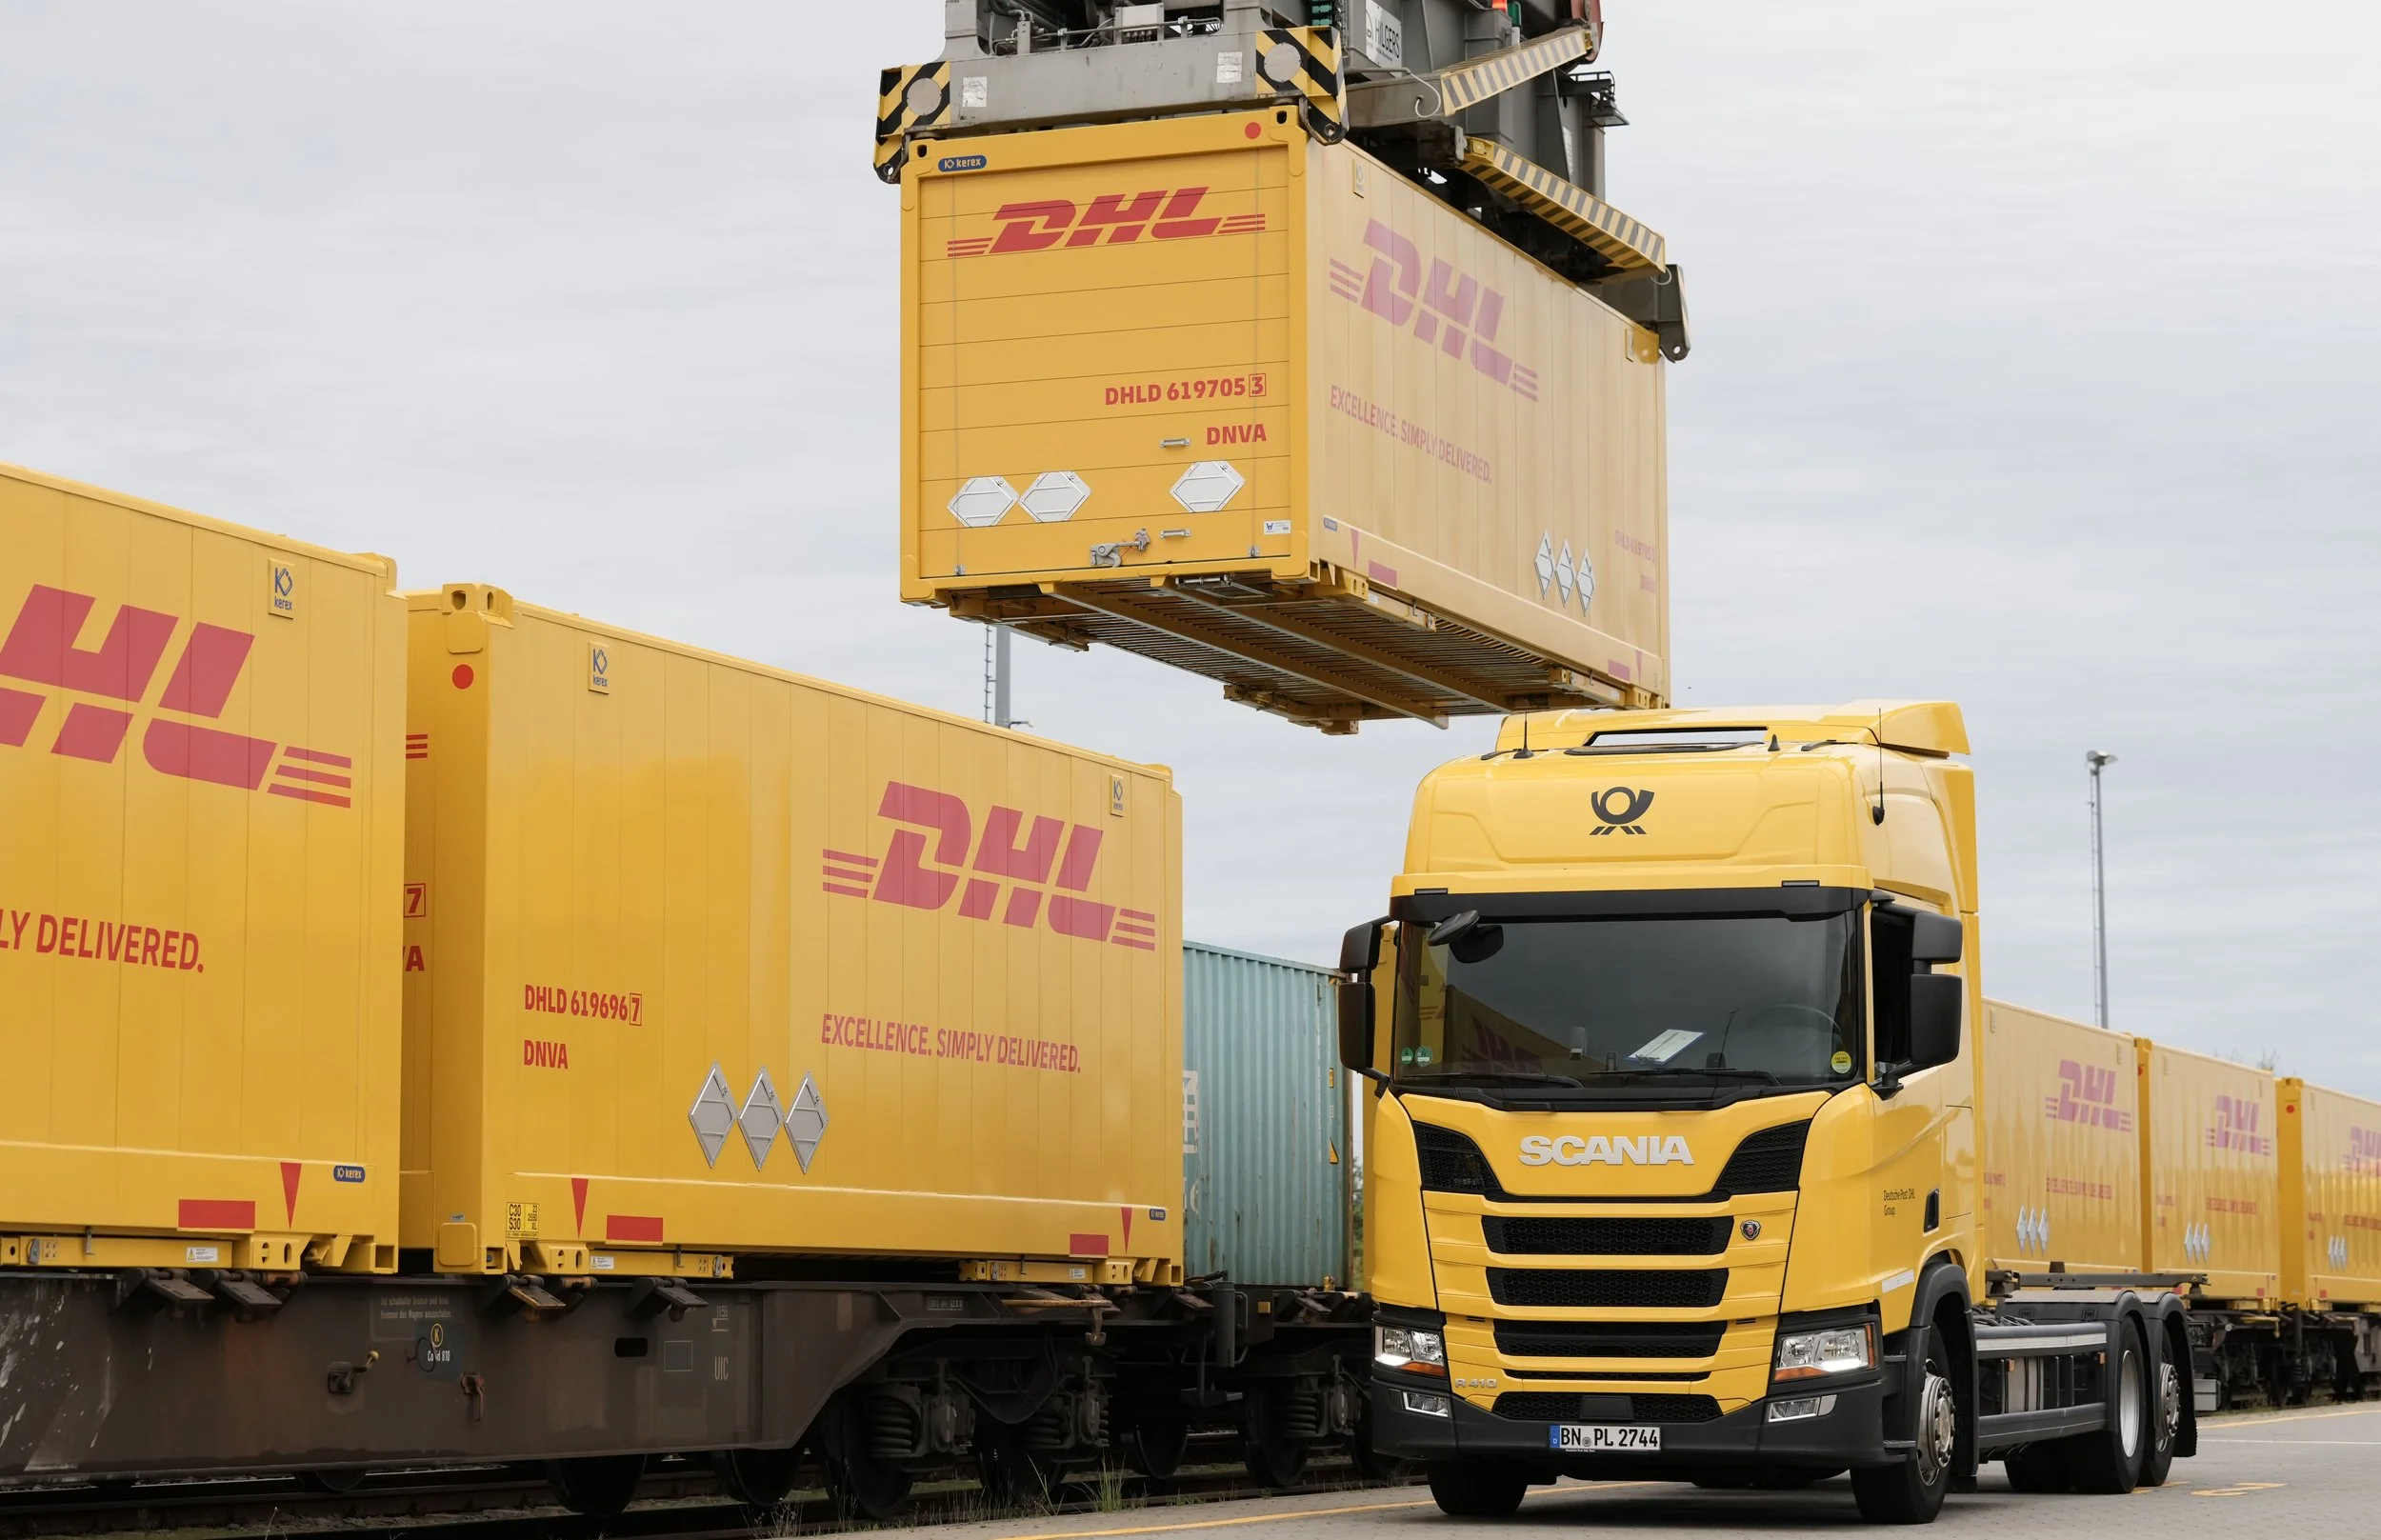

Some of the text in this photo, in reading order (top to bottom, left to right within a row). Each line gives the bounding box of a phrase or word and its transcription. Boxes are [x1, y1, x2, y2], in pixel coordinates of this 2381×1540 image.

[1374, 17, 1400, 58] HILGERS
[956, 158, 981, 168] kerex
[989, 187, 1223, 254] DHL
[1360, 218, 1512, 386] DHL
[1105, 384, 1161, 406] DHLD
[1167, 377, 1246, 401] 619705
[1206, 423, 1267, 445] DNVA
[1330, 384, 1492, 484] EXCELLENCE. SIMPLY DELIVERED.
[274, 595, 292, 610] kerex
[0, 584, 277, 790] HL
[872, 780, 1116, 943] DHL
[35, 913, 204, 973] DELIVERED.
[525, 984, 567, 1013] DHLD
[570, 990, 628, 1021] 619696
[524, 1039, 569, 1070] DNVA
[821, 1013, 1081, 1073] EXCELLENCE. SIMPLY DELIVERED.
[2058, 1059, 2121, 1130] DHL
[2215, 1095, 2262, 1154] DHL
[1519, 1135, 1694, 1167] SCANIA
[346, 1168, 362, 1179] kerex
[714, 1356, 729, 1381] UIC
[1454, 1378, 1497, 1389] R 410
[1561, 1428, 1581, 1446] BN
[1594, 1429, 1613, 1446] PL
[1618, 1429, 1658, 1447] 2744
